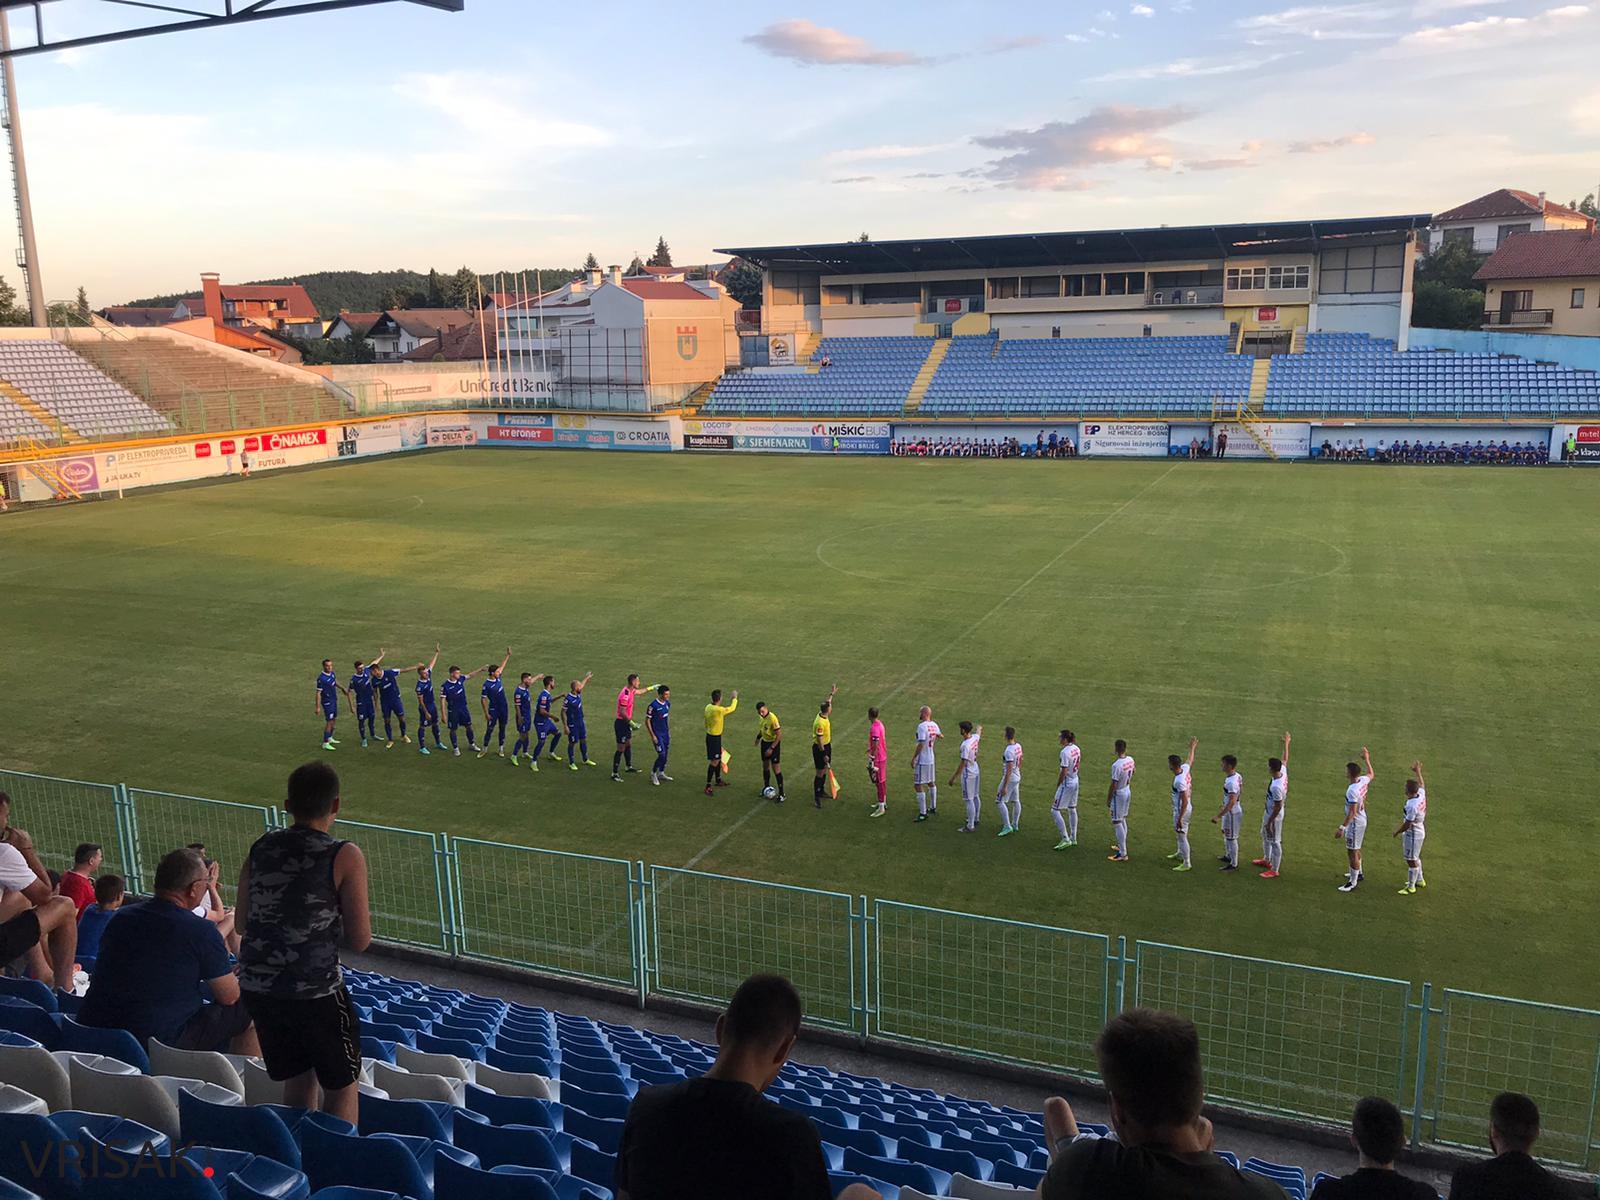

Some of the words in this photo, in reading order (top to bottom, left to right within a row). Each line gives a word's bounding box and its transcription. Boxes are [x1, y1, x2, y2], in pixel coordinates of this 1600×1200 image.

[460, 378, 517, 393] UniCredt
[520, 378, 552, 393] Bank
[828, 423, 865, 436] MIŠKIĆ
[865, 425, 888, 436] BUS
[442, 433, 462, 441] DELTA
[629, 431, 670, 441] CROATIA
[749, 437, 807, 448] SJEMENARNA
[258, 458, 286, 468] FUTURA
